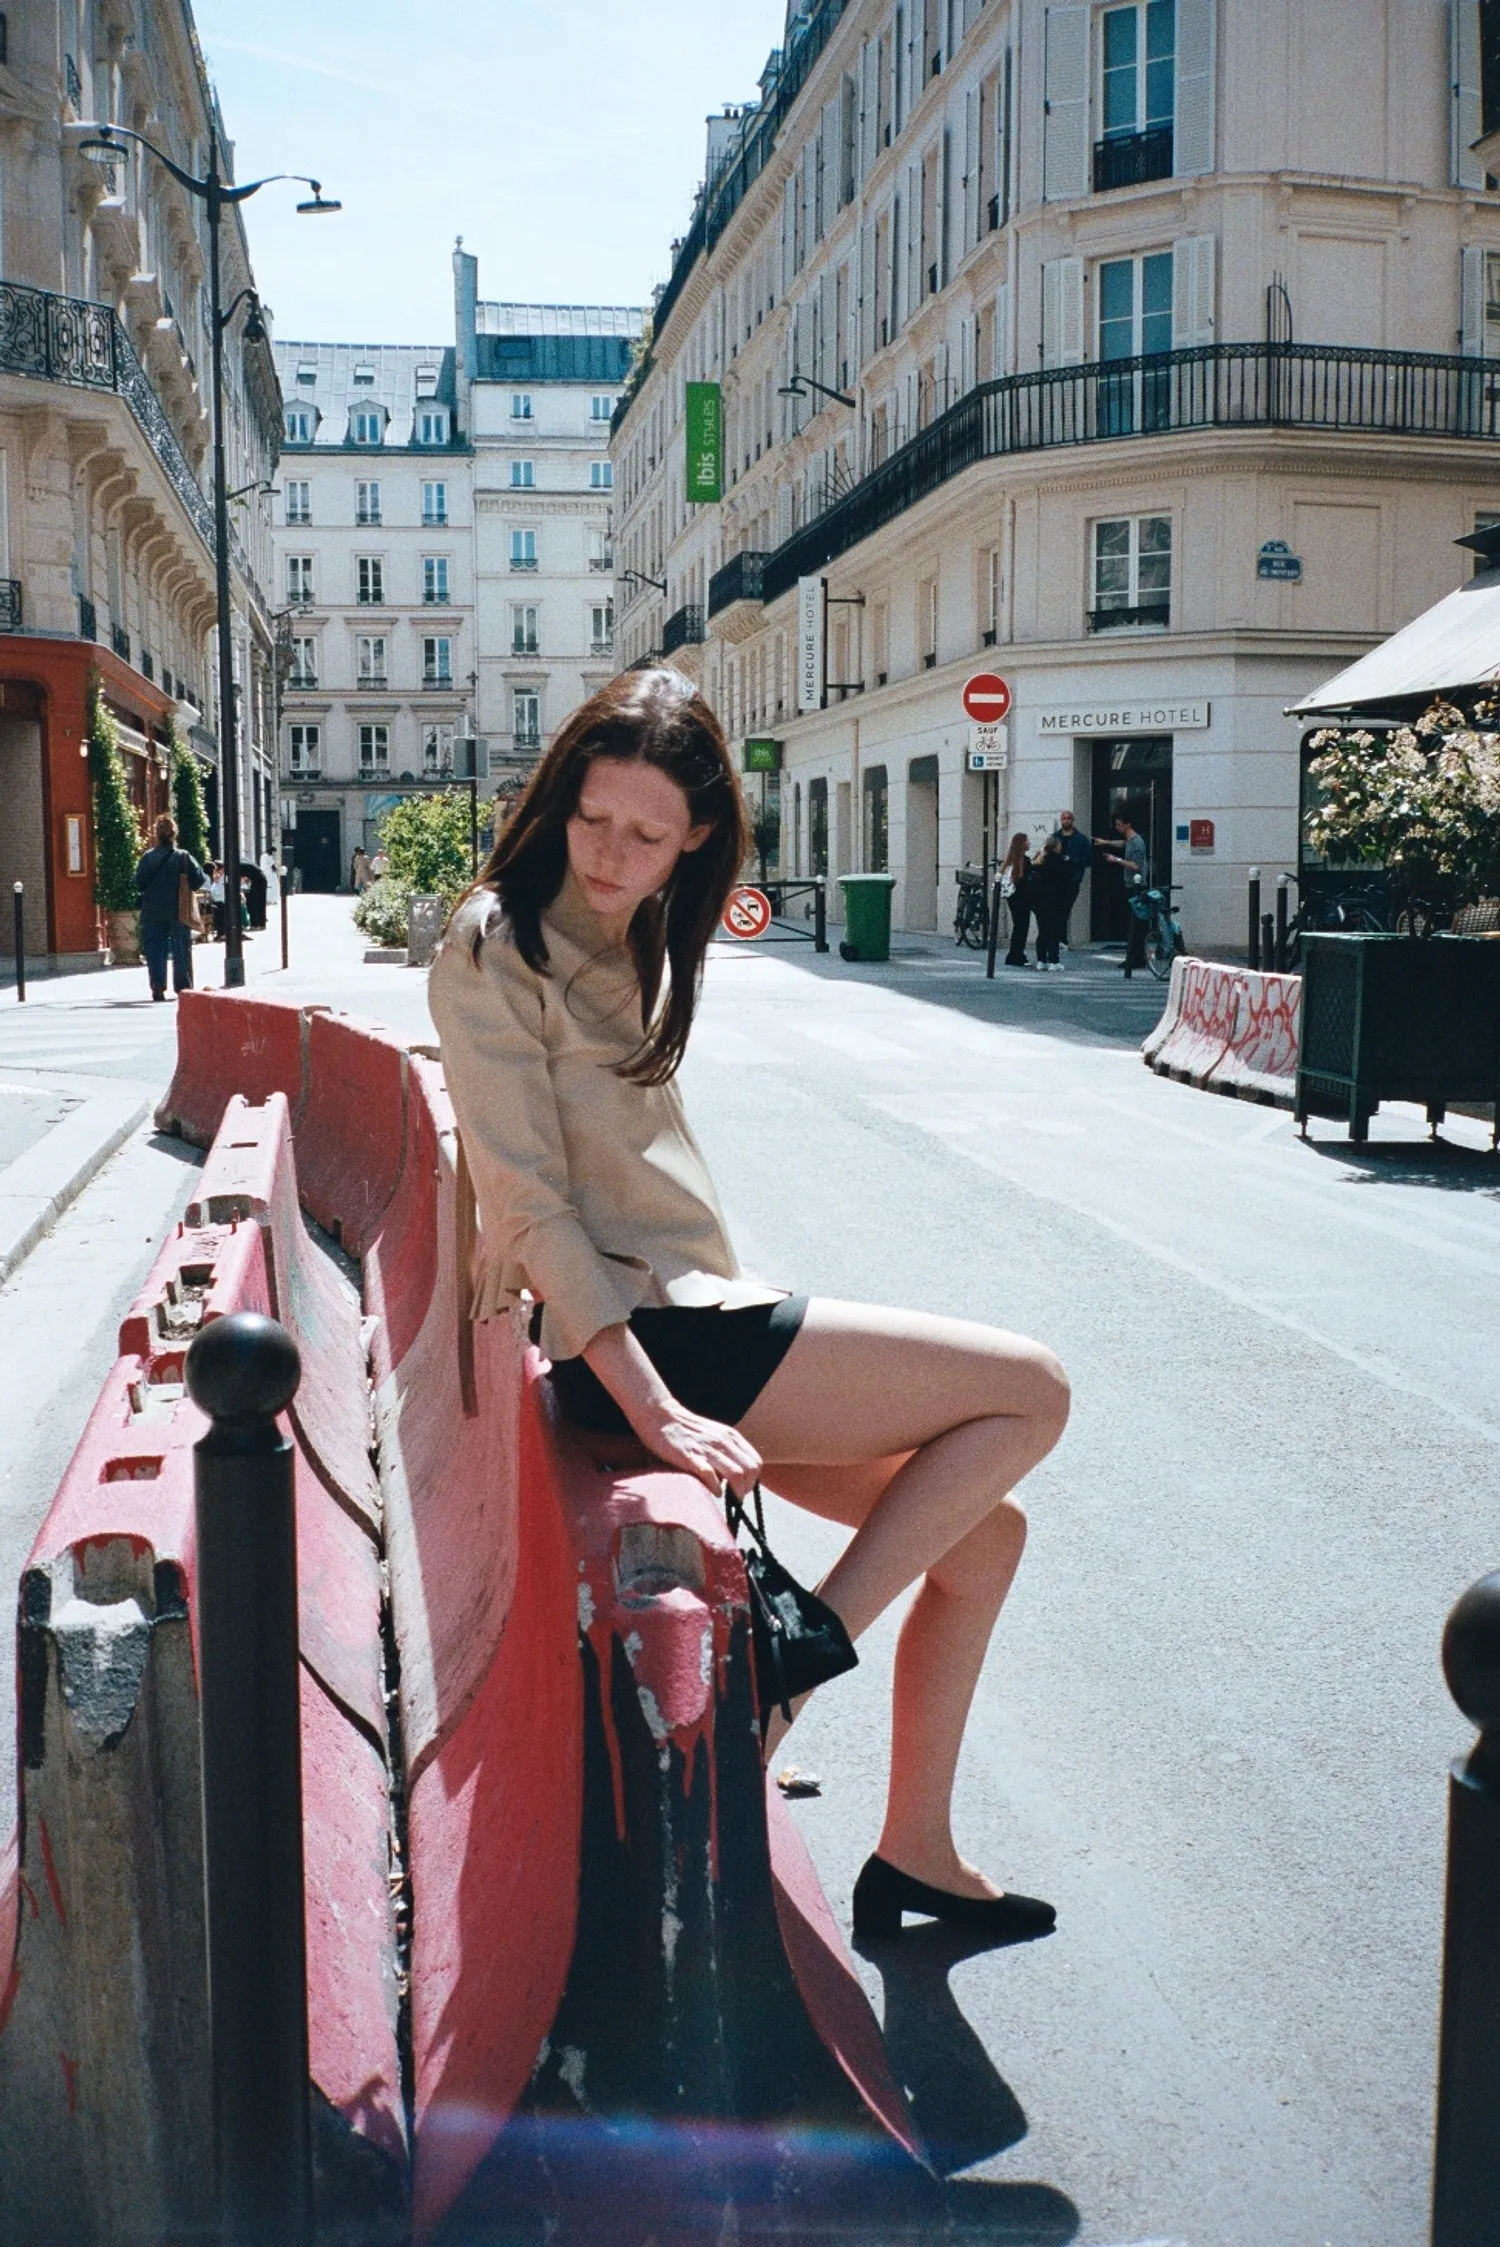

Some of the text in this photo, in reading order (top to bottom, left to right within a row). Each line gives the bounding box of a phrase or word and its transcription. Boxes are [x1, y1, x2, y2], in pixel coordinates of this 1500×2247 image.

[696, 452, 715, 486] ibis
[805, 587, 814, 700] MERCURE HOTEL
[977, 726, 999, 734] SAUF
[1041, 708, 1201, 728] MERCURE HOTEL
